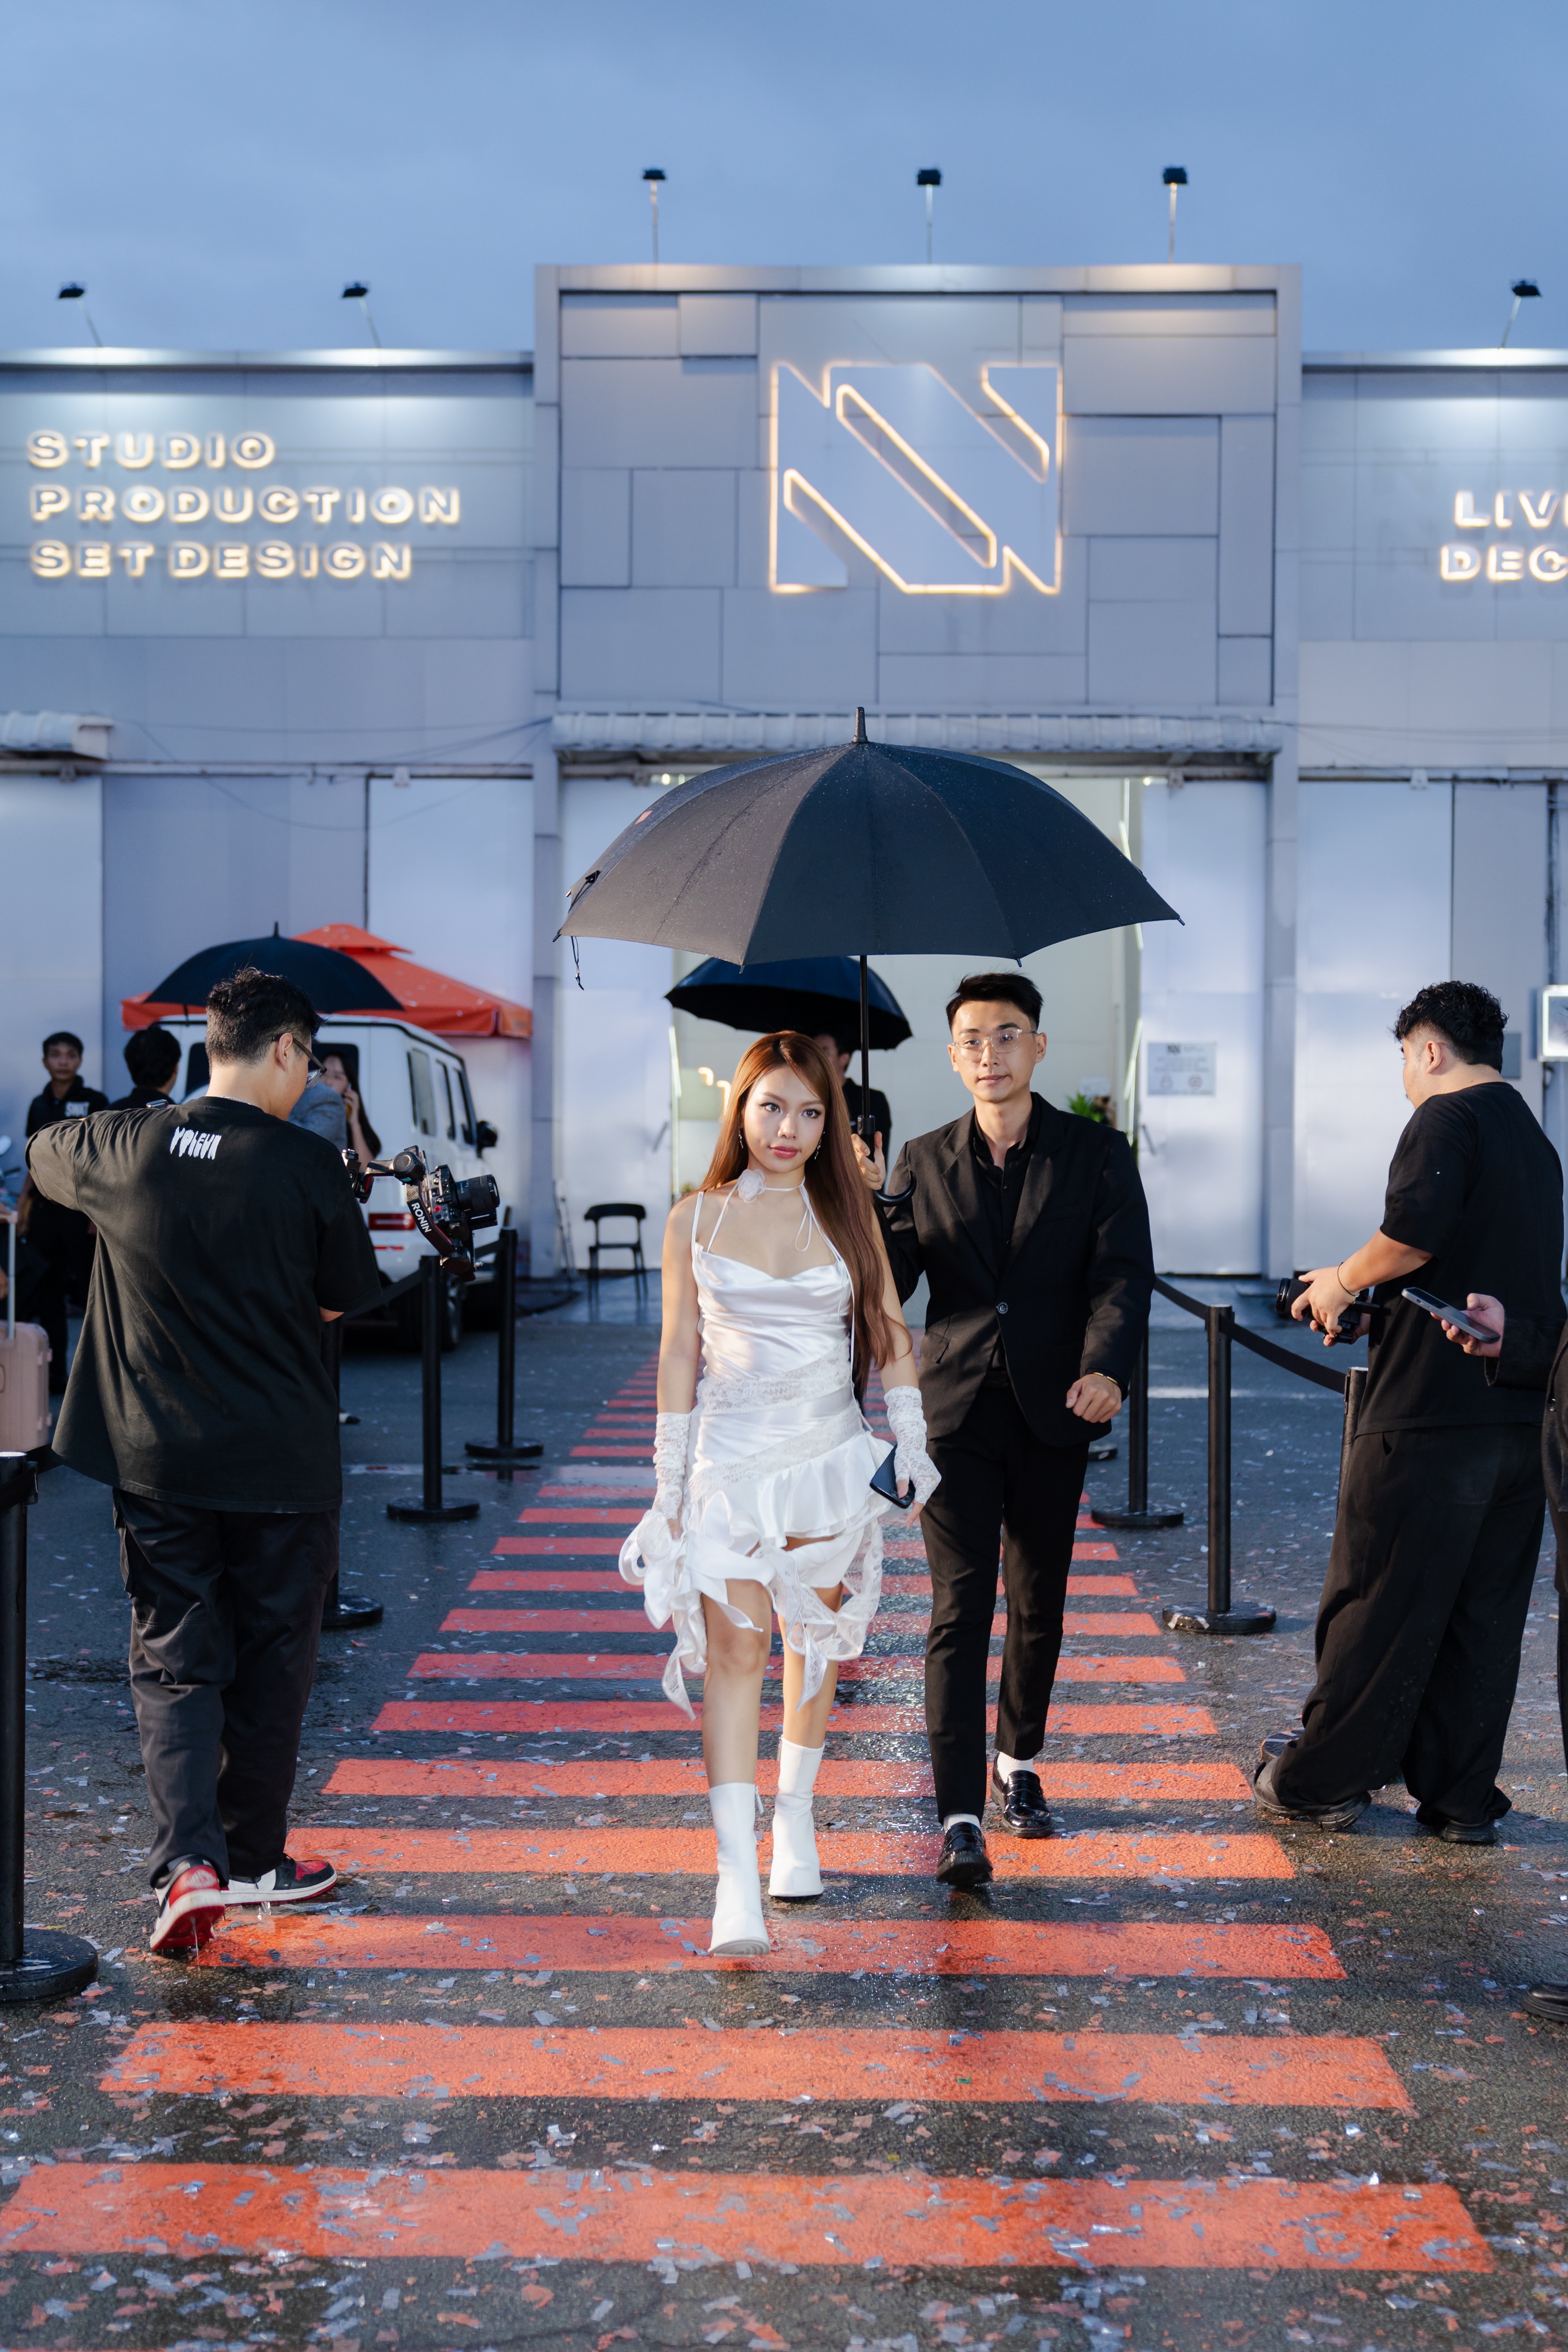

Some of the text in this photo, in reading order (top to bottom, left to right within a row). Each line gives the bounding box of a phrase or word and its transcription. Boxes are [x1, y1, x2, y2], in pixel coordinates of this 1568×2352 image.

[28, 430, 275, 468] STUDIO
[31, 485, 461, 524] PRODUCTION
[1454, 490, 1568, 528] LIV
[31, 541, 412, 579] SET DESIGN
[65, 1101, 90, 1117] SWAT
[411, 1202, 432, 1233] RONIN
